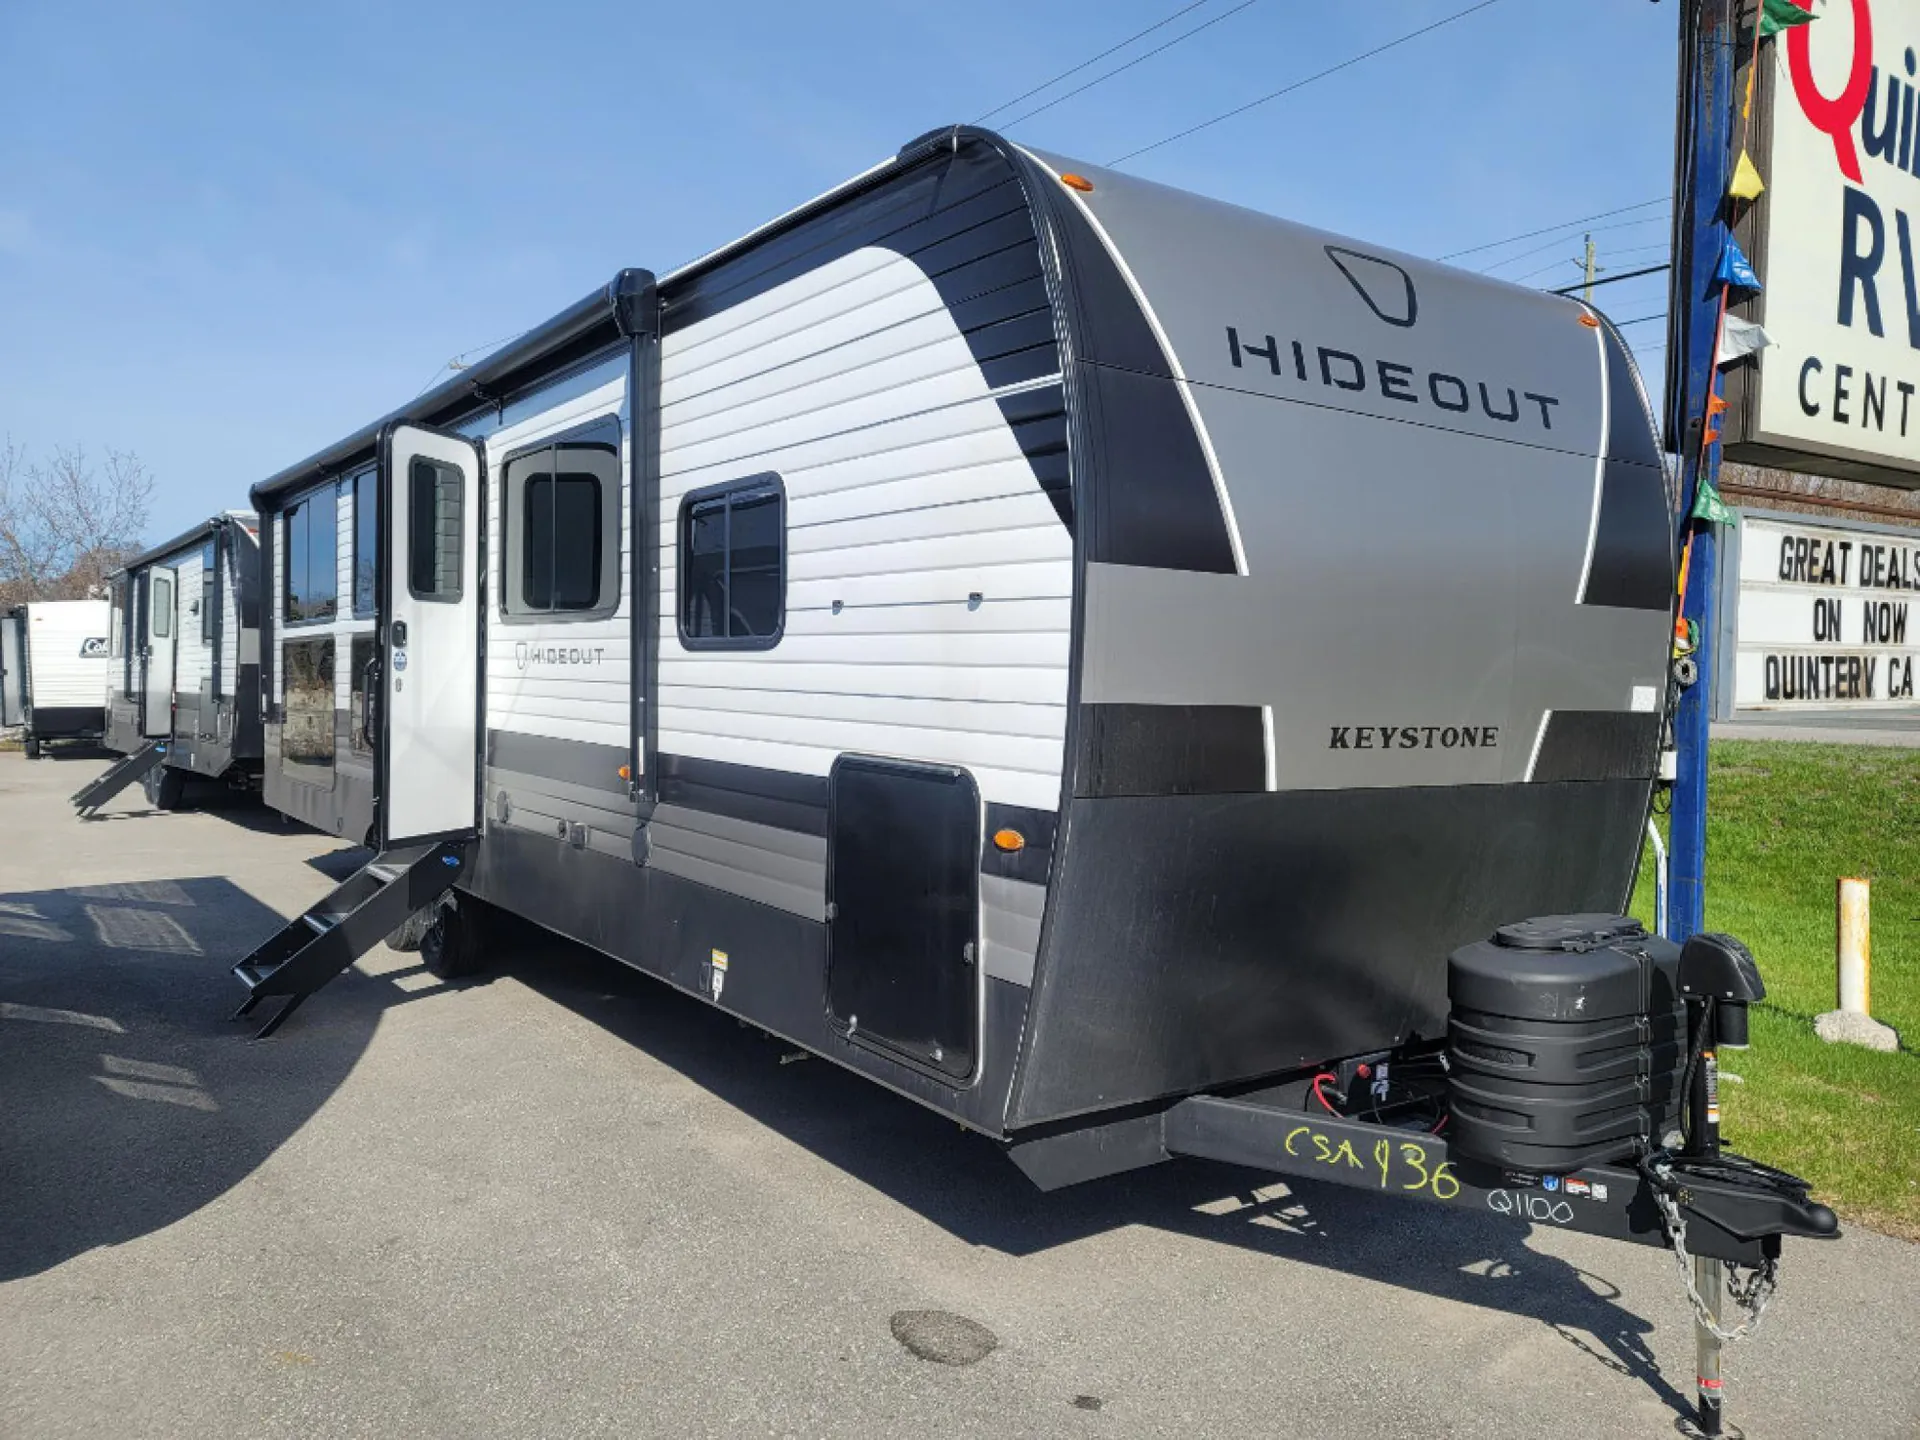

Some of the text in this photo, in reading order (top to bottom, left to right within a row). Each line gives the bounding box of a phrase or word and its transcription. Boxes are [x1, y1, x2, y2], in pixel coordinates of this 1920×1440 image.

[1786, 0, 1920, 186] Qui
[1226, 326, 1559, 430] HIDEOUT
[1779, 535, 1852, 585] GREAT
[1813, 597, 1908, 644] ON NOW
[530, 647, 605, 665] HIDEOUT
[1765, 655, 1913, 700] QUINTERV CA
[1329, 726, 1499, 749] KEYSTONE
[1285, 1126, 1365, 1170] CSA
